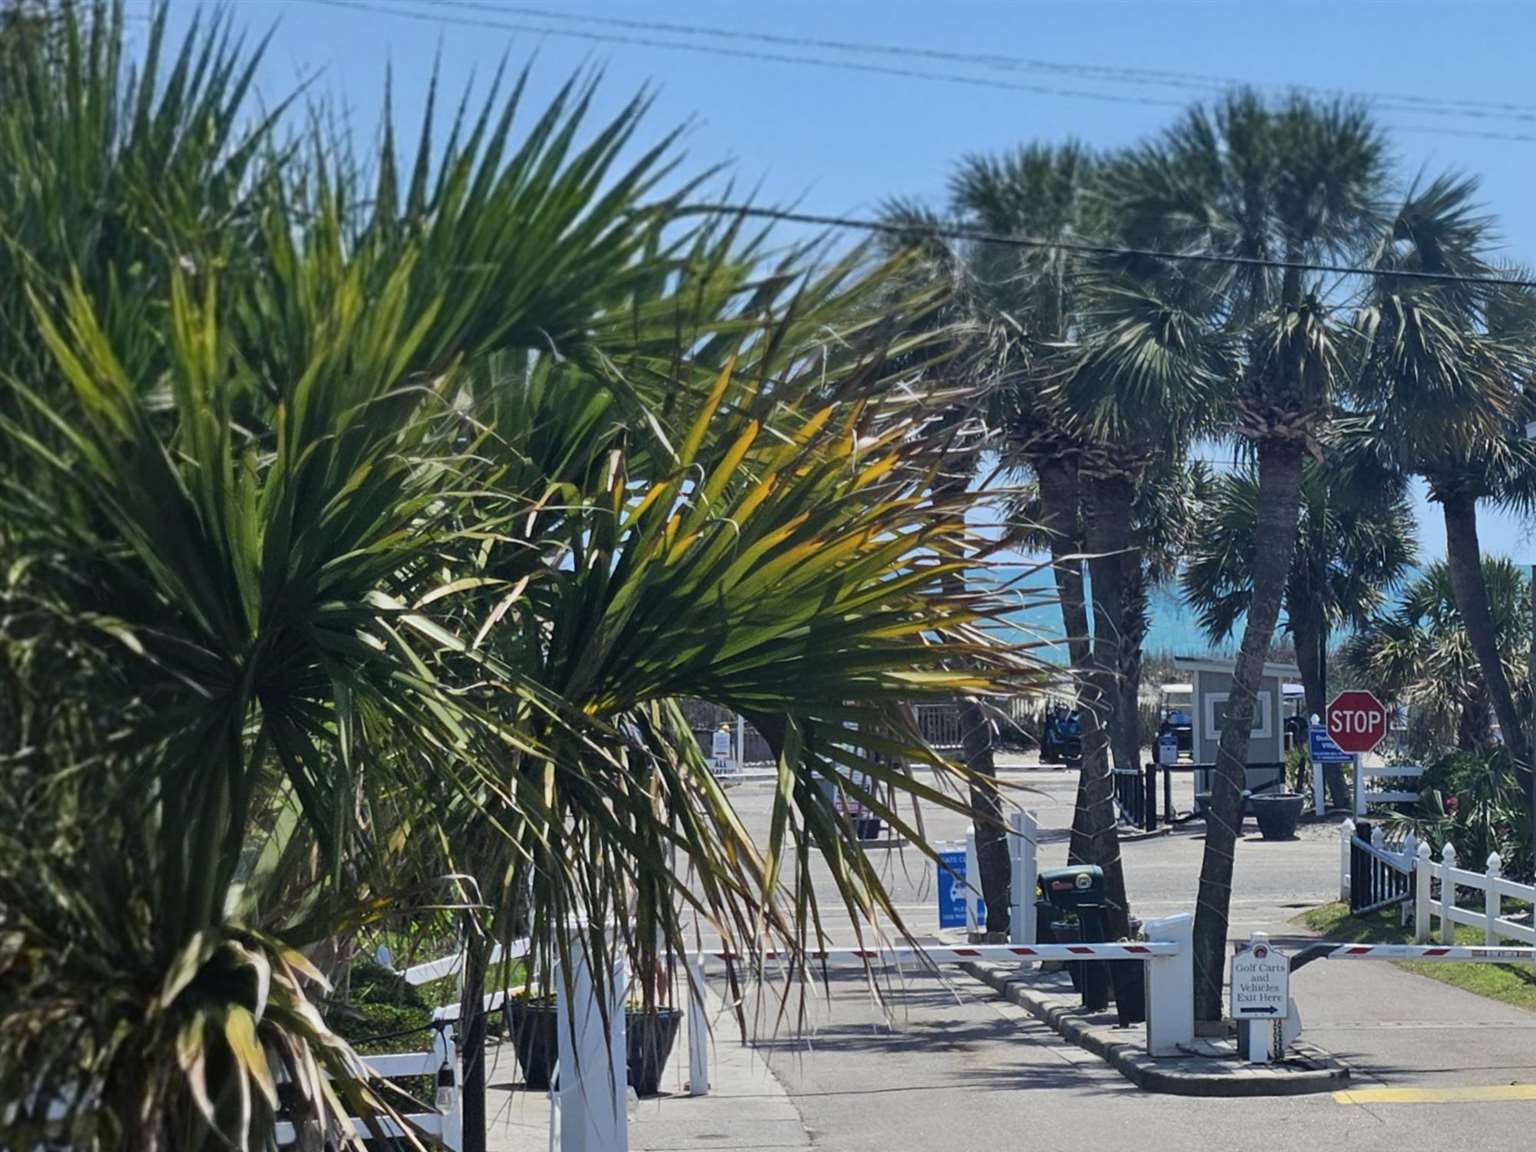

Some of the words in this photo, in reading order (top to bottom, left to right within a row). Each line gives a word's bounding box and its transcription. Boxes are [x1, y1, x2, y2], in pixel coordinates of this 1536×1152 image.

[1331, 710, 1381, 733] STOP
[1235, 963, 1257, 972] Golf
[1258, 963, 1286, 972] Carts
[1251, 973, 1269, 982] and
[1240, 983, 1280, 992] Vehicles
[1237, 993, 1256, 1002] Exit
[1259, 993, 1281, 1001] Here
